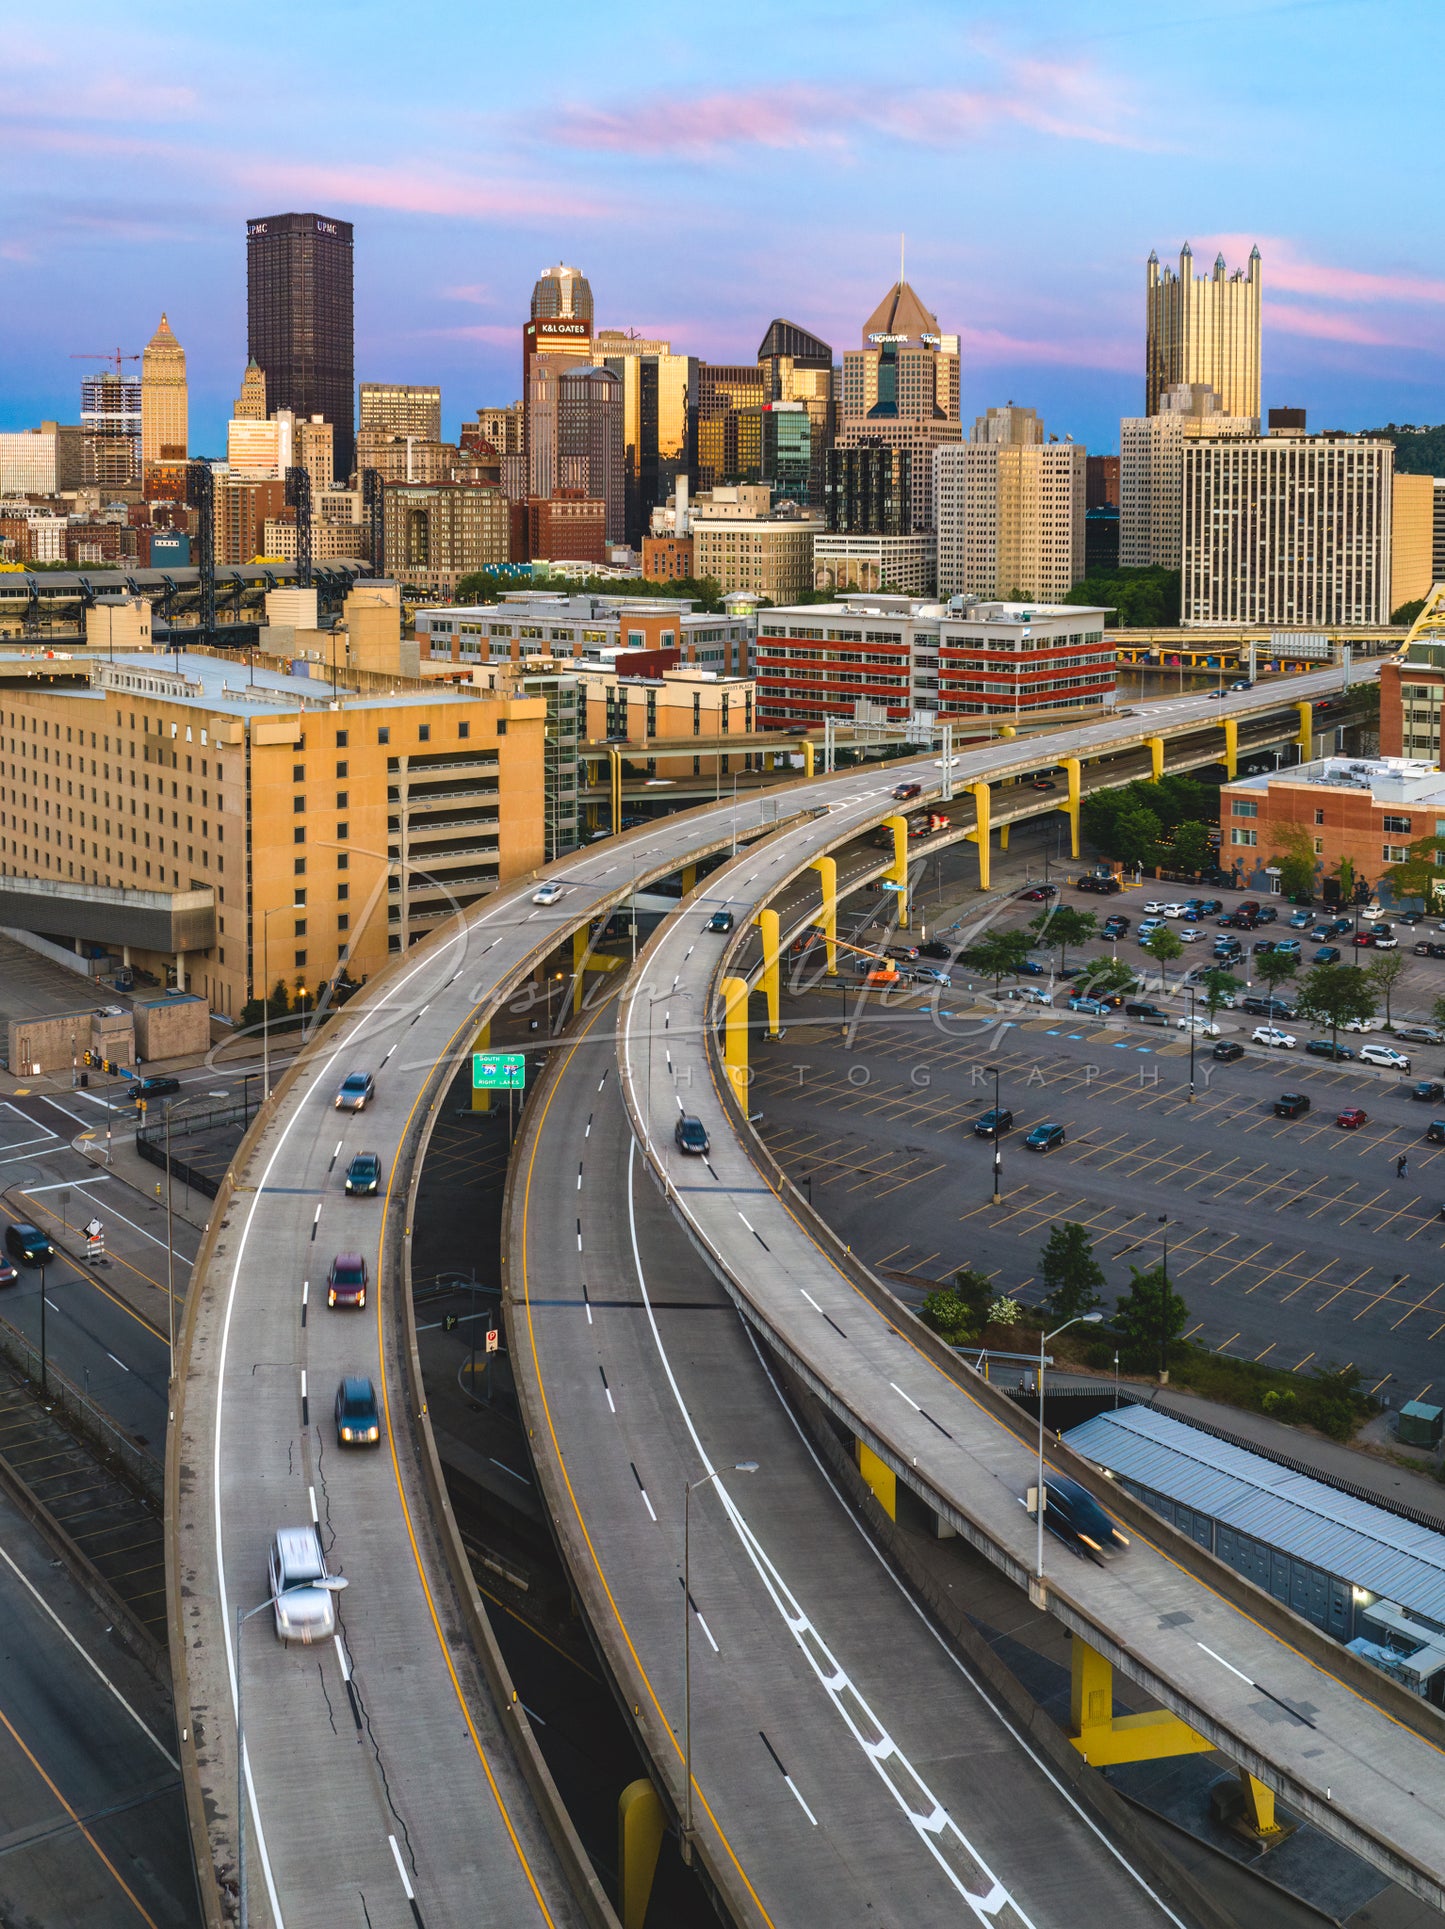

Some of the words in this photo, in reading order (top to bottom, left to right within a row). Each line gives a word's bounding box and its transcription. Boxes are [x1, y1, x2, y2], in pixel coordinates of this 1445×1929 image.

[247, 223, 268, 235] UPMC
[317, 220, 337, 235] UPMC
[542, 324, 557, 334] K&L
[558, 324, 585, 334] GATES
